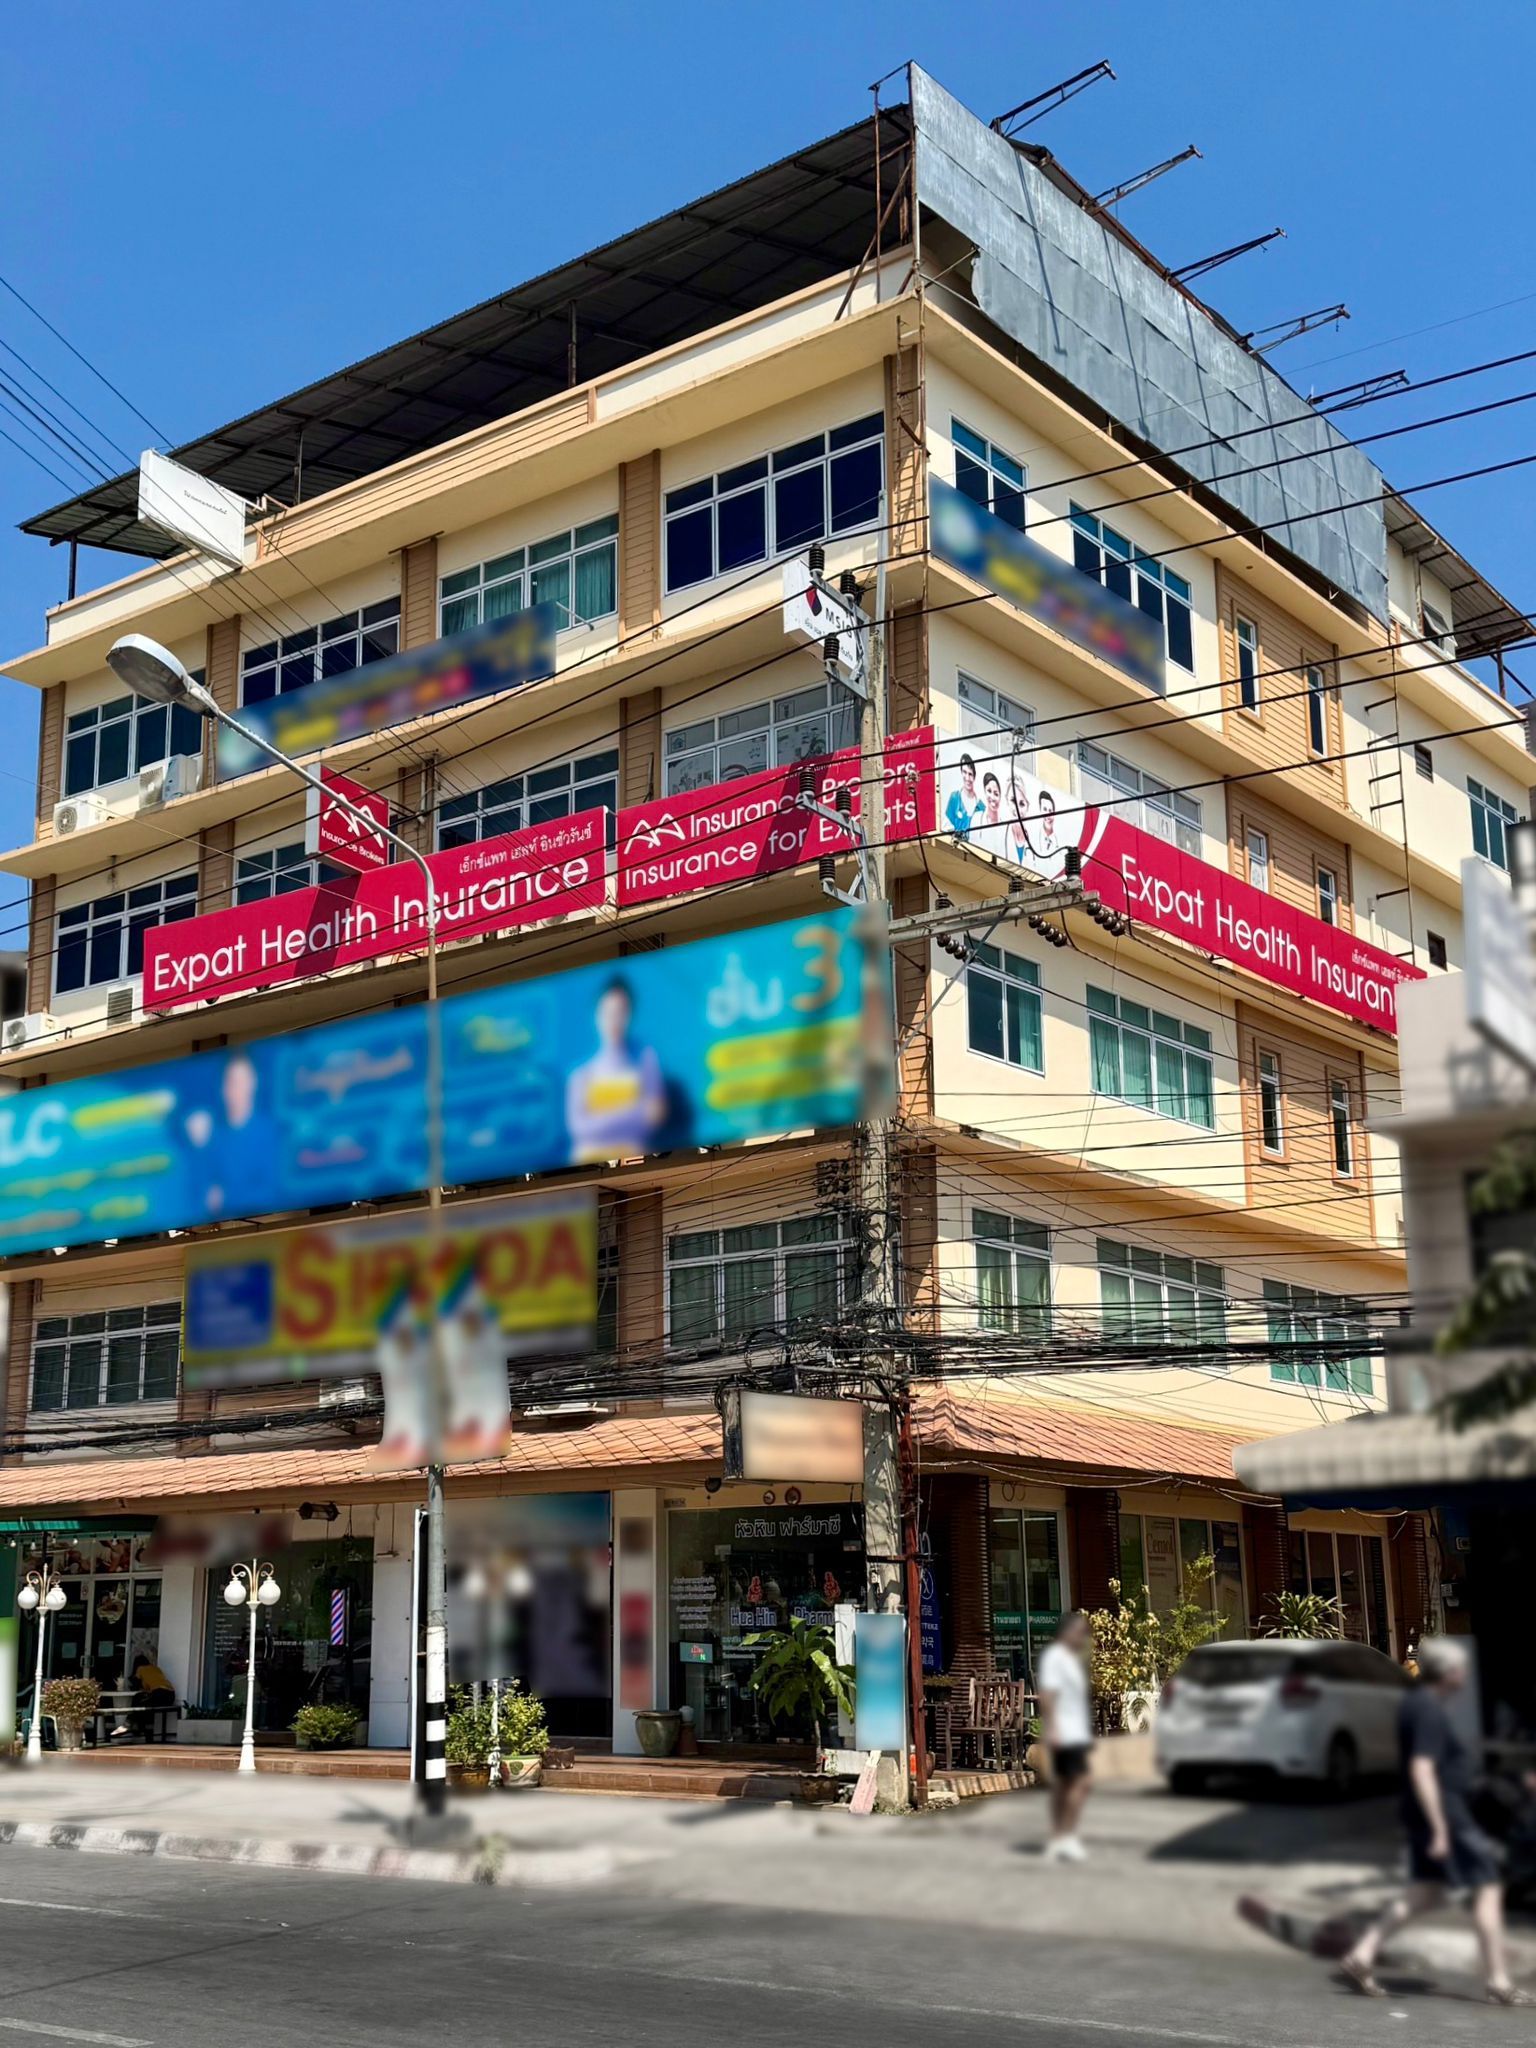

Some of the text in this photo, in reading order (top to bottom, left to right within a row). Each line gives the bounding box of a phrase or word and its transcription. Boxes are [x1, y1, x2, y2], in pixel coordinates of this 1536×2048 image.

[822, 761, 916, 805] Broers
[321, 828, 385, 865] Insurance Brokers
[626, 841, 758, 890] Insurance
[767, 827, 807, 855] for
[153, 856, 590, 993] Expat Health Insurance
[1121, 853, 1396, 1017] Expat Health Insuran
[734, 1518, 777, 1538] หัวหิน
[730, 1606, 754, 1627] Hua
[755, 1606, 778, 1627] Hin
[793, 1606, 836, 1627] Pharm
